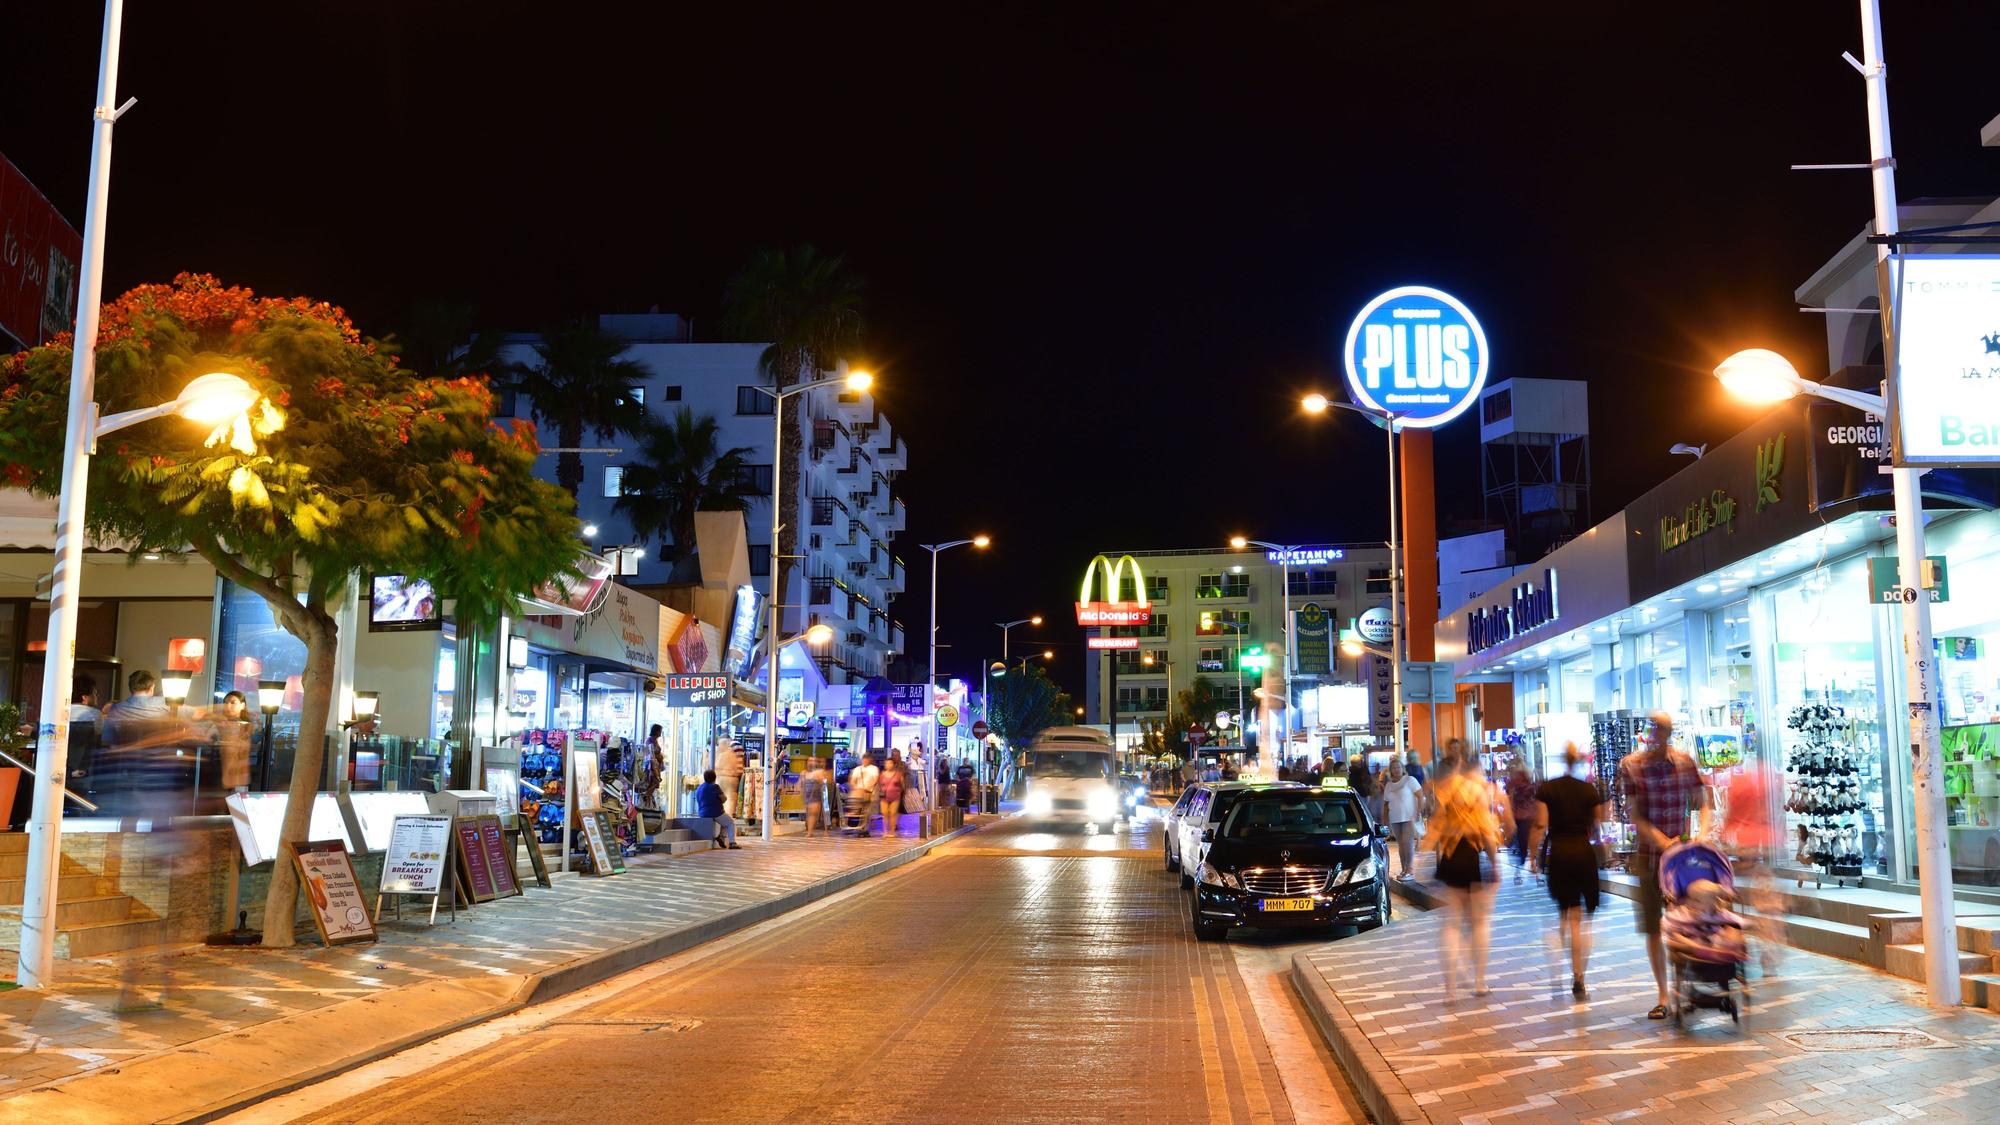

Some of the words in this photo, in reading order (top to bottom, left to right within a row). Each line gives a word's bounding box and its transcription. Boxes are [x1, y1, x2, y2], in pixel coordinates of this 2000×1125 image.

[20, 248, 44, 292] you
[1362, 324, 1471, 389] PLUS
[1709, 489, 1735, 535] Shop
[1080, 611, 1148, 621] McDonald's
[1467, 604, 1513, 656] Atlantis
[1512, 567, 1558, 635] Island
[670, 677, 727, 689] LEPUS
[691, 691, 706, 703] GIFT
[707, 689, 726, 700] SHOP
[909, 686, 923, 698] BAR
[897, 703, 911, 712] BAR
[1292, 900, 1311, 909] 707
